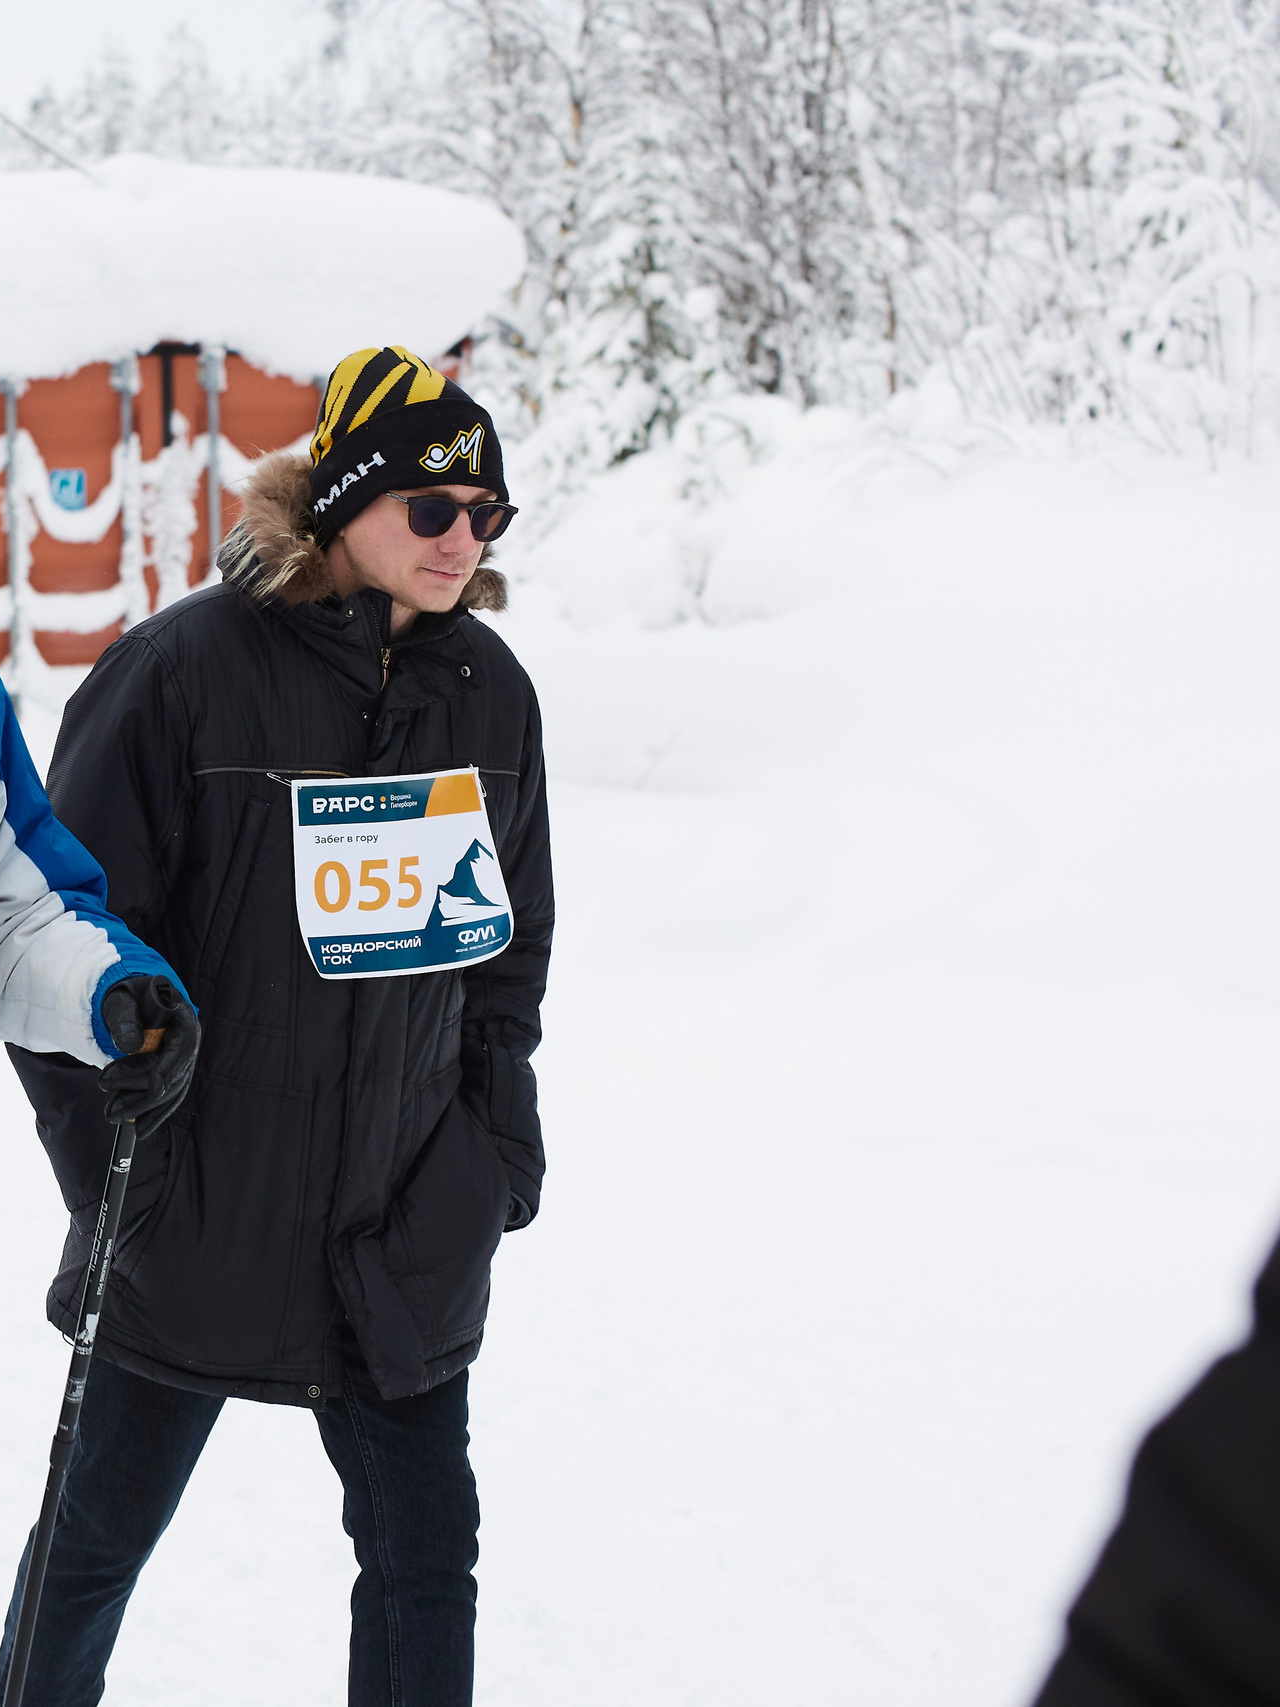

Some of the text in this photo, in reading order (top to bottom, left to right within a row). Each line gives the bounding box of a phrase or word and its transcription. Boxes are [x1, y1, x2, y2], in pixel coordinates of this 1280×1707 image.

[312, 796, 375, 814] ВАРС
[314, 835, 344, 844] Забег
[356, 834, 379, 844] гору
[314, 856, 422, 913] 055
[321, 935, 422, 954] КОВДОРСКИЙ
[322, 955, 353, 966] ГОК
